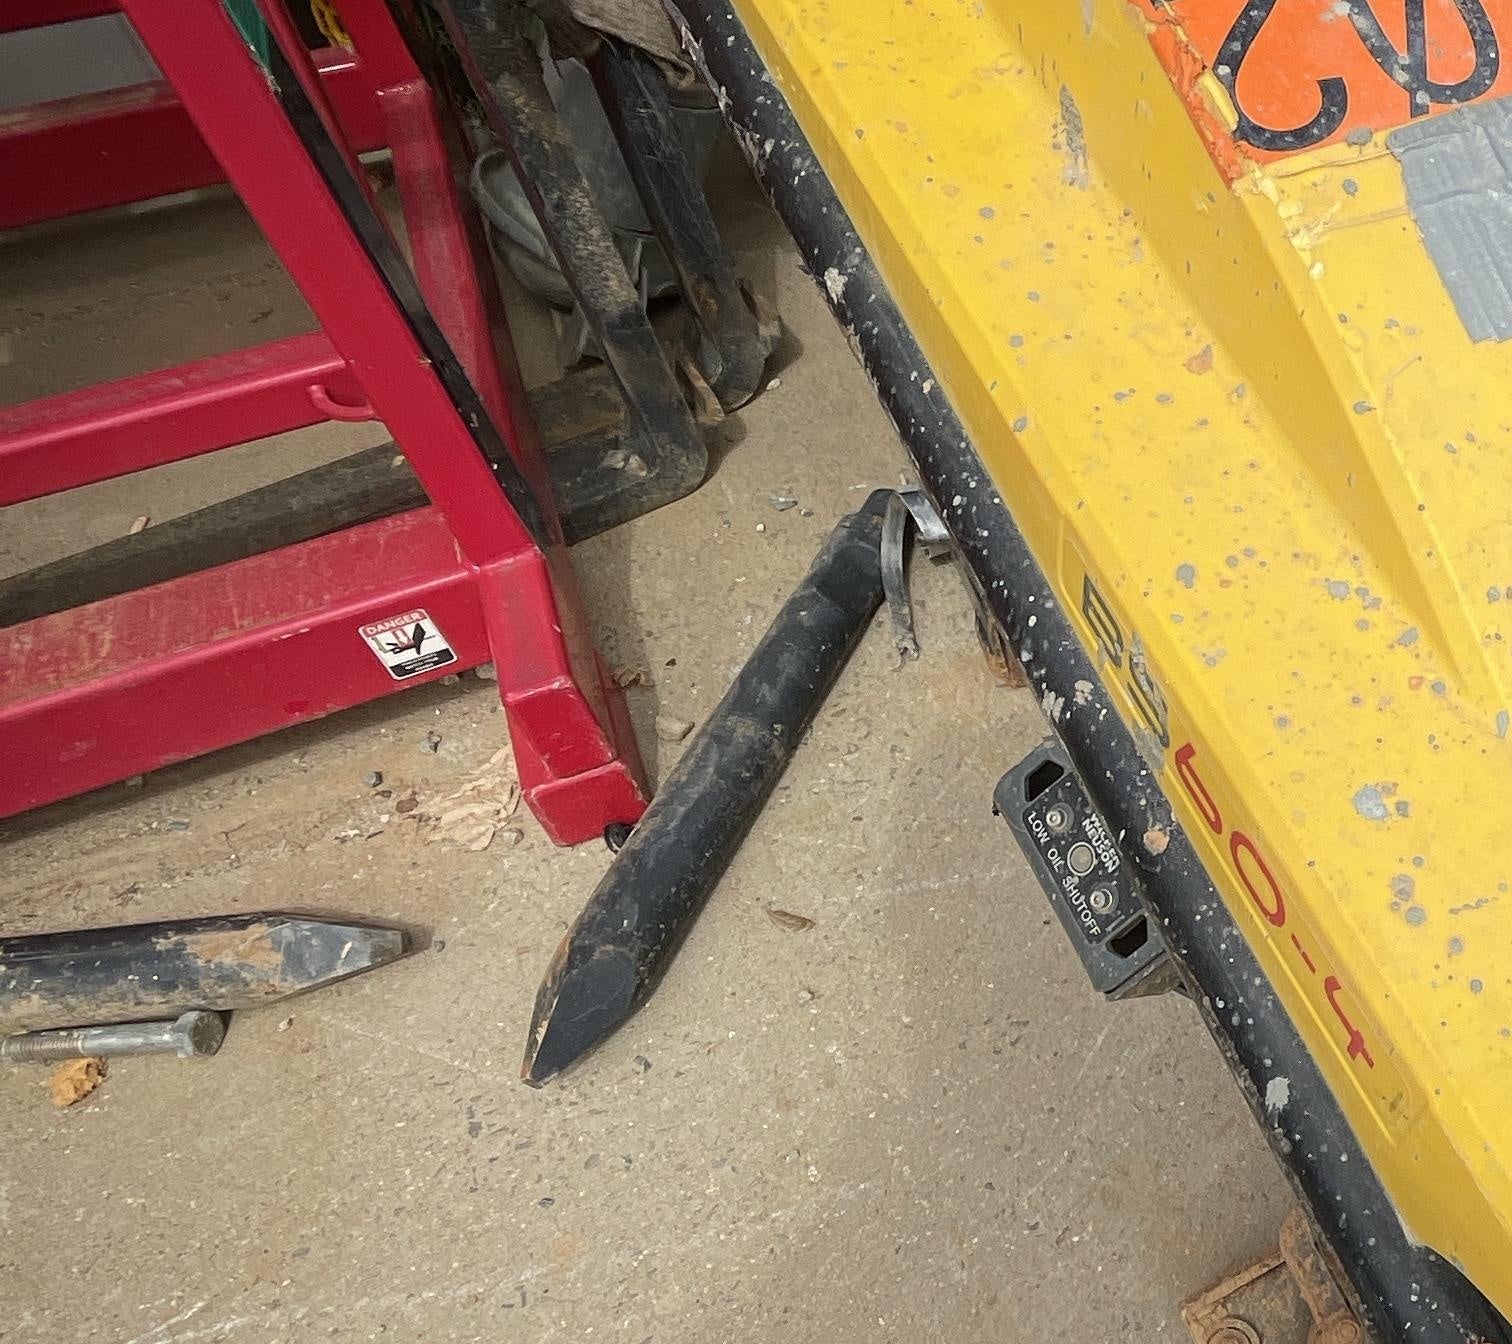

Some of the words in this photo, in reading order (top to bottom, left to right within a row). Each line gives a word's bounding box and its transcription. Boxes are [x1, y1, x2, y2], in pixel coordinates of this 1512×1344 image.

[365, 611, 422, 635] DANGER
[1027, 810, 1051, 844] LOW
[1047, 847, 1066, 873] OIL
[1062, 875, 1102, 936] SHUTOFF
[1081, 817, 1119, 874] NEUSON
